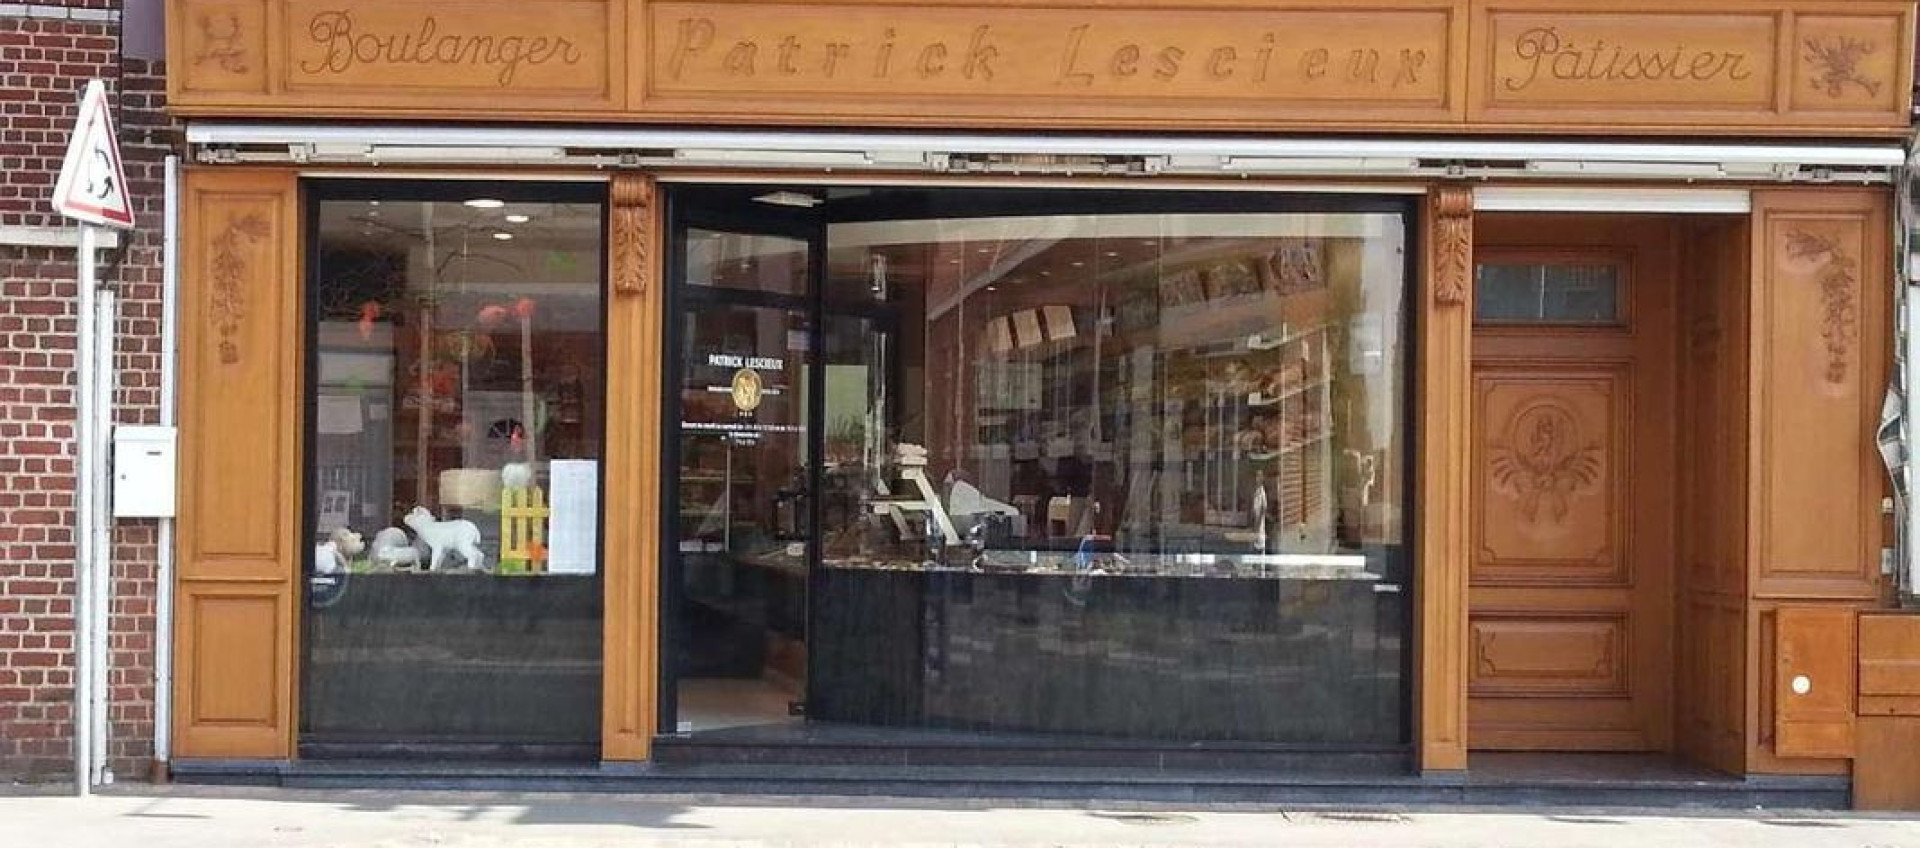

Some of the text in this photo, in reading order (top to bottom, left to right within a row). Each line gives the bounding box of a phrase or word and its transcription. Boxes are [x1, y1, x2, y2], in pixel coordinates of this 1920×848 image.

[301, 10, 581, 86] Boulanger
[667, 16, 1428, 88] Patrick Lescieux
[708, 354, 744, 368] PATRICK
